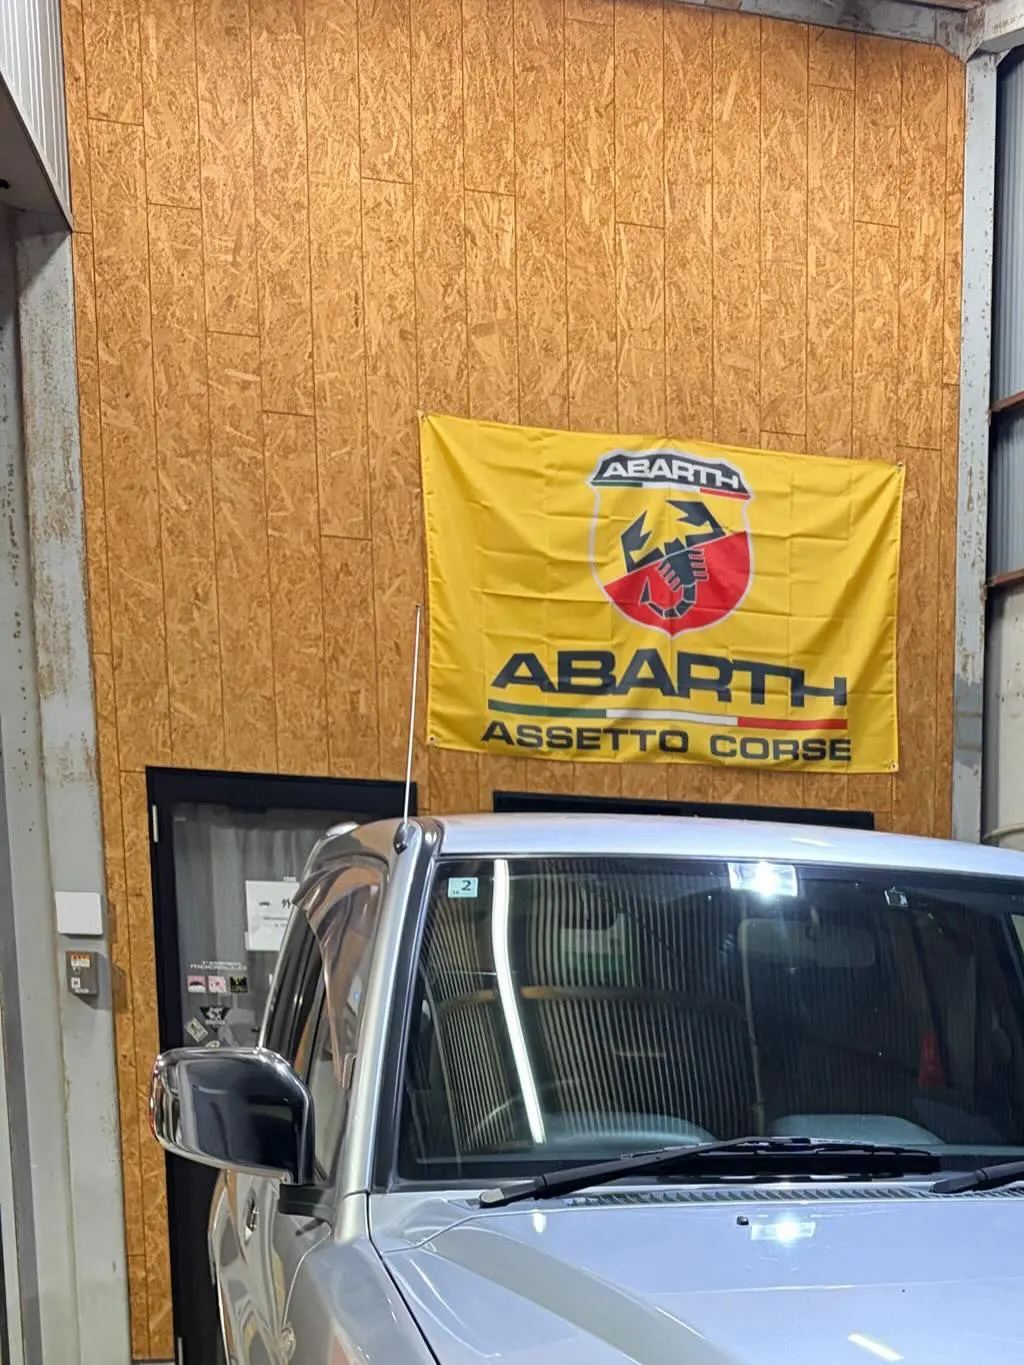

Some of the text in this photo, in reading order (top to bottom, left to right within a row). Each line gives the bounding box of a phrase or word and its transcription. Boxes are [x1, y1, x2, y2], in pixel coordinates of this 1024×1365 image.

[603, 458, 740, 489] ABARTH
[491, 648, 848, 707] ABARTH
[480, 720, 853, 762] ASSETTO CORSE
[461, 879, 472, 891] 2
